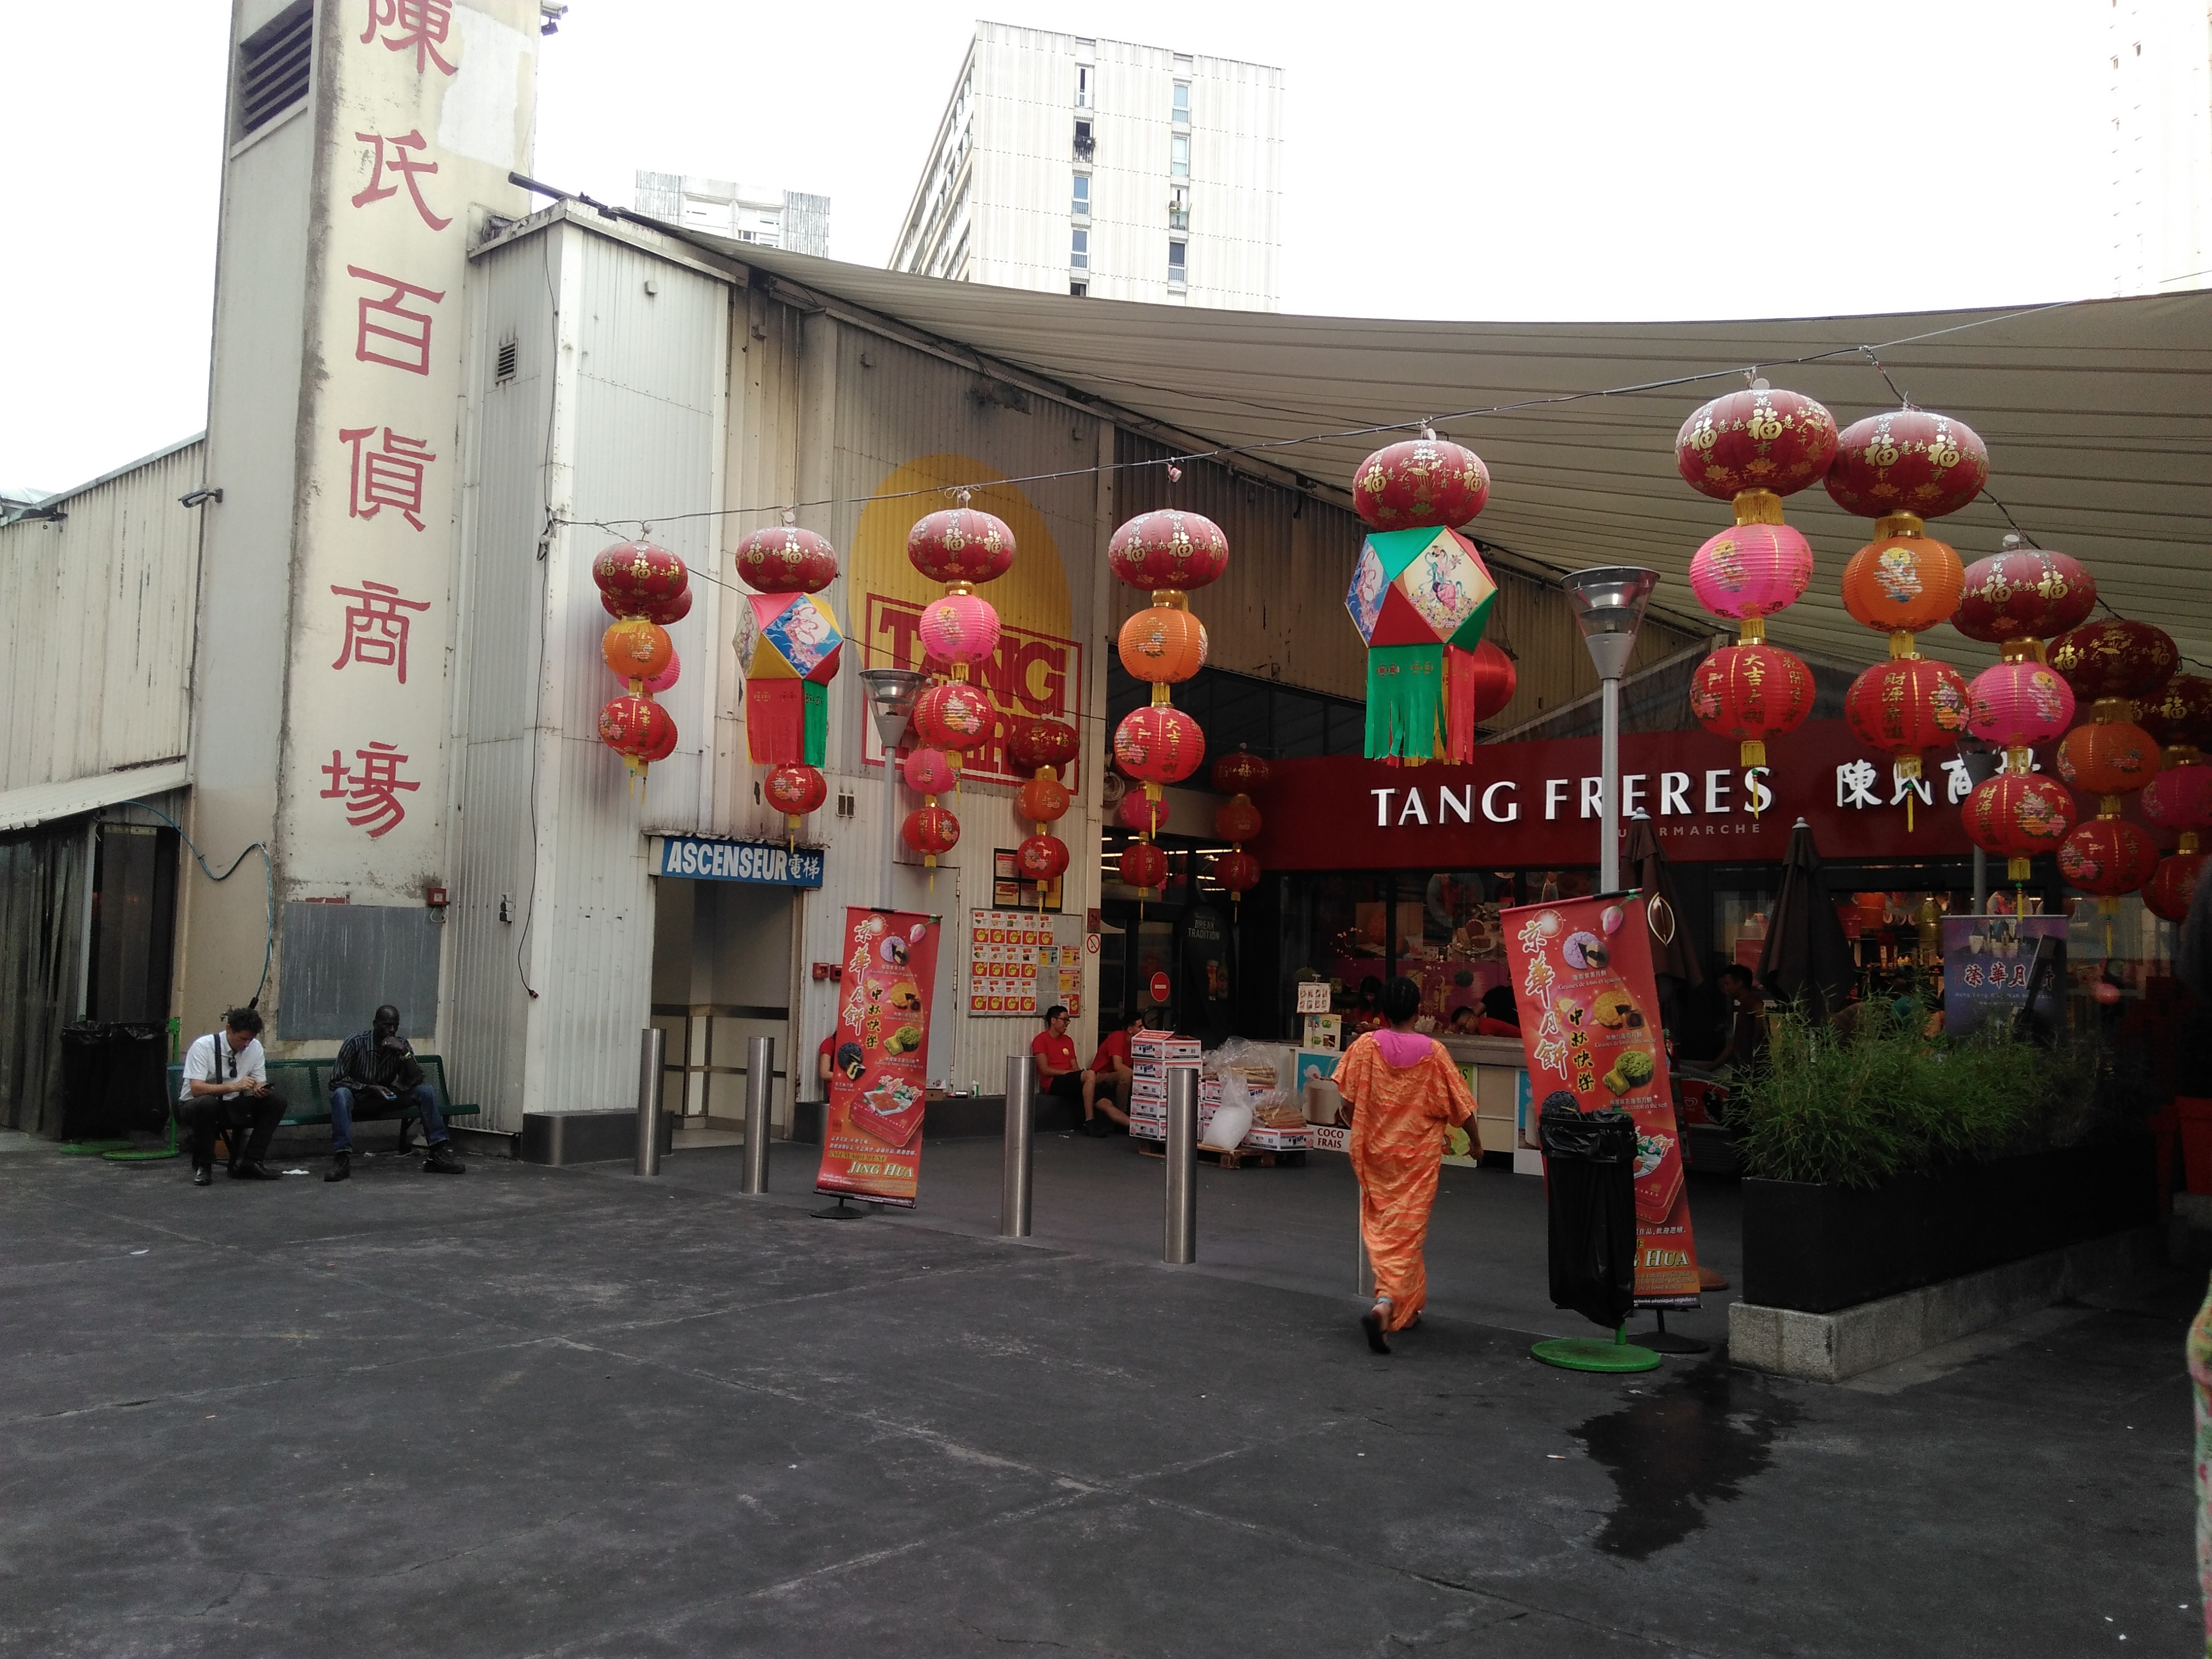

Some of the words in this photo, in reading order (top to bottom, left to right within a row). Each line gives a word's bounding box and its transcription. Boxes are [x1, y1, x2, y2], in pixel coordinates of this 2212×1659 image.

[1371, 781, 1519, 827] TANG
[1545, 767, 1773, 820] FRERES
[667, 841, 787, 881] ASCENSEUR
[788, 854, 820, 880] 電梯
[1195, 920, 1215, 930] BREAK
[1188, 928, 1220, 940] TRADITION
[842, 920, 872, 1036] 京華月餅
[1518, 920, 1568, 1080] 京華月餅
[1570, 1008, 1594, 1092] 中秋快樂
[1317, 1128, 1344, 1138] COCO
[1318, 1138, 1341, 1149] FRAIS
[848, 1162, 880, 1175] JING
[884, 1164, 913, 1178] HUA
[1645, 1250, 1690, 1267] HUA
